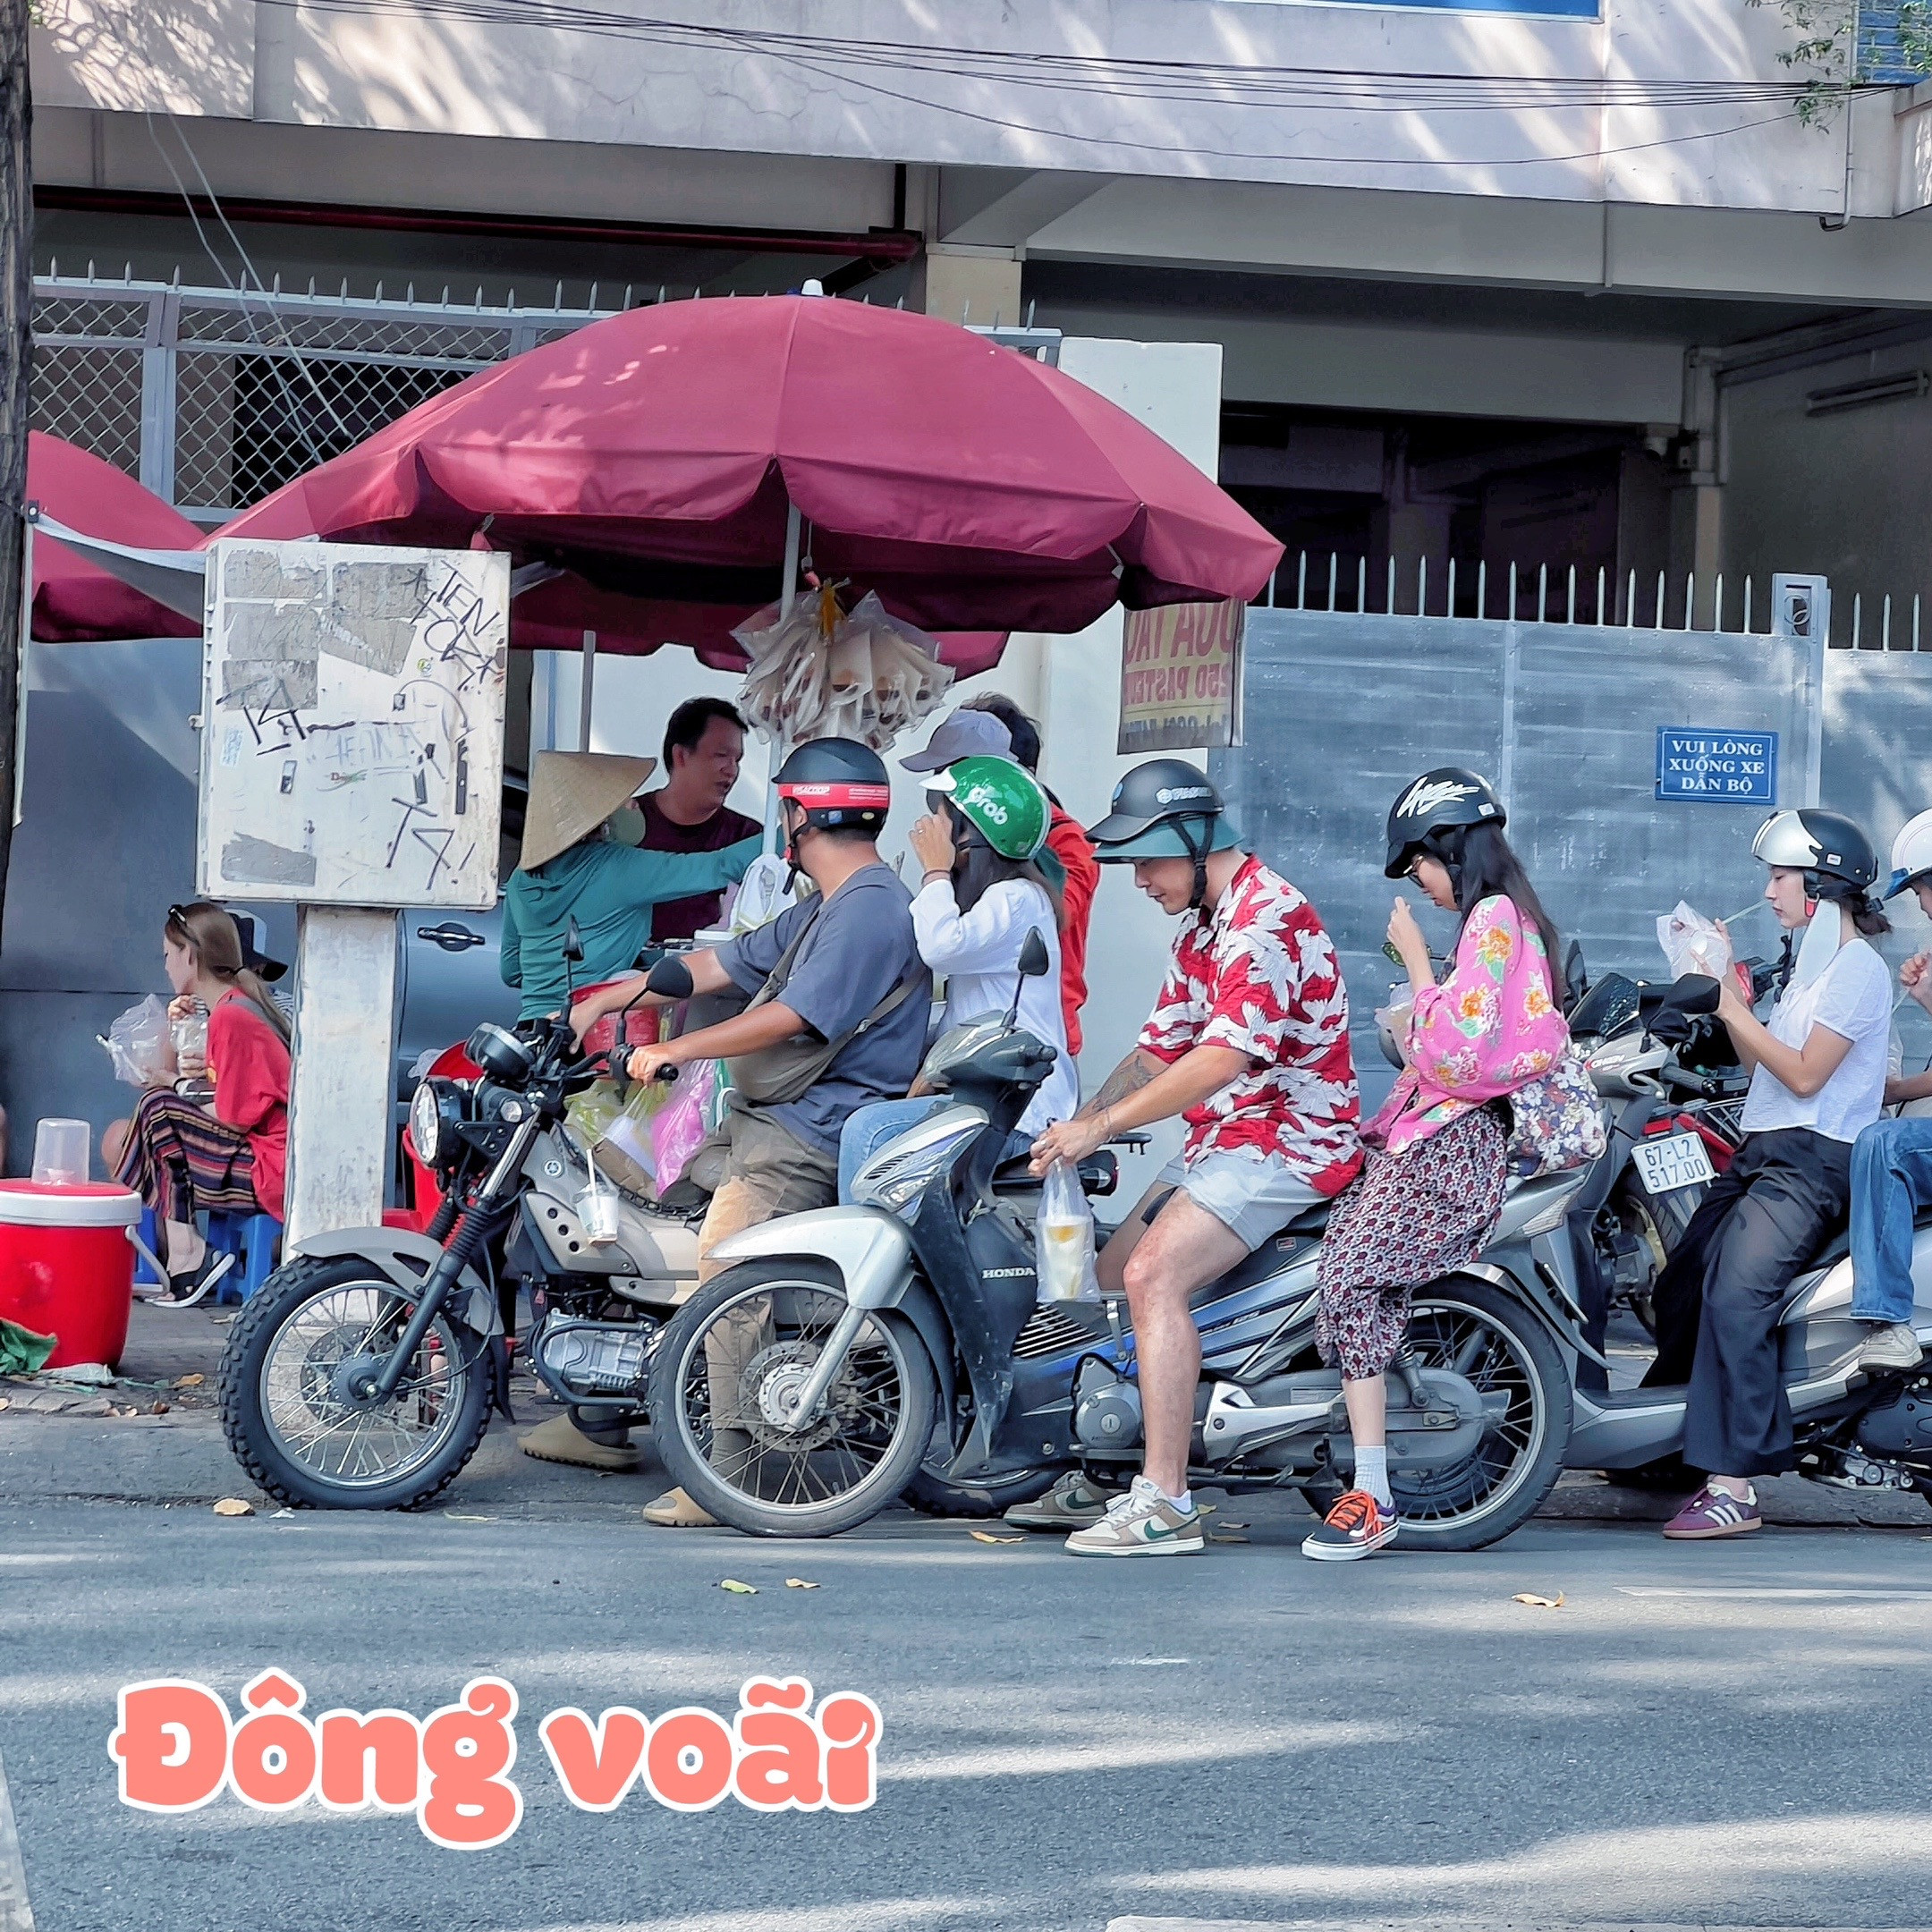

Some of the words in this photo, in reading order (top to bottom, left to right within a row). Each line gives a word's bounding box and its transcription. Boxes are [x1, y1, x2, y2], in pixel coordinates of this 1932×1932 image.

[1671, 740, 1706, 753] VUI
[1711, 738, 1763, 756] LÒNG
[1669, 754, 1735, 773] XUỐNG
[1740, 761, 1765, 775] XE
[1682, 772, 1722, 791] DẪN
[1726, 775, 1753, 795] BỘ
[1643, 1138, 1695, 1167] 67-L2
[1647, 1157, 1707, 1189] 517.00
[981, 1267, 1037, 1279] HONDA
